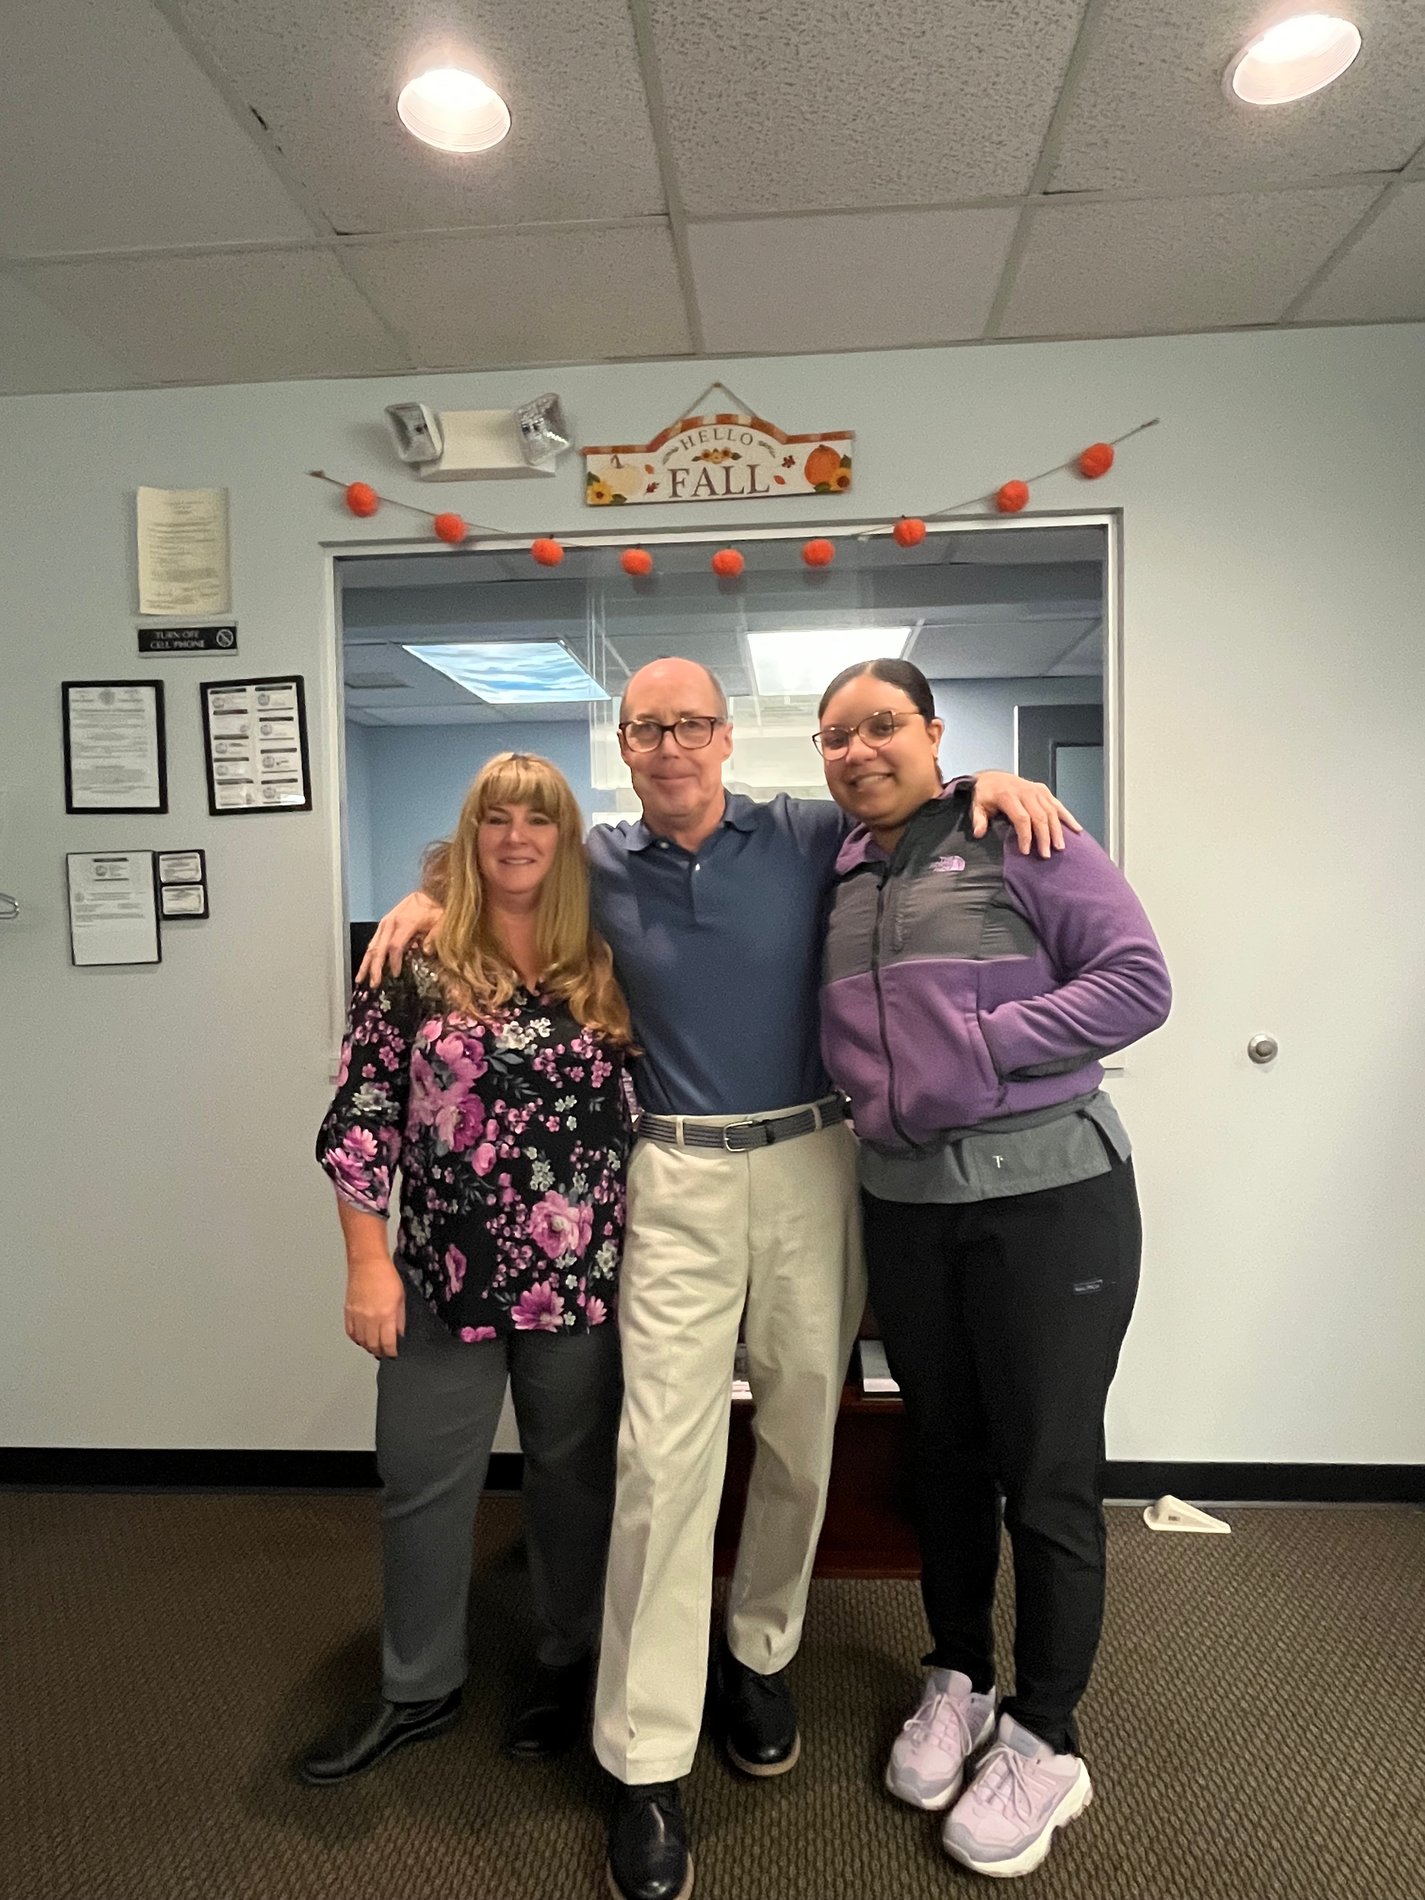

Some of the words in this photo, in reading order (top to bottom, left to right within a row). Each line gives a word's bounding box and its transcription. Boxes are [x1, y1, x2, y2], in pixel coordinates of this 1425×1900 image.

[679, 428, 754, 451] HELLO
[667, 464, 770, 499] FALL
[154, 631, 180, 639] TURN
[182, 630, 200, 638] OFF
[150, 640, 171, 649] CELL
[174, 639, 205, 648] PHONE
